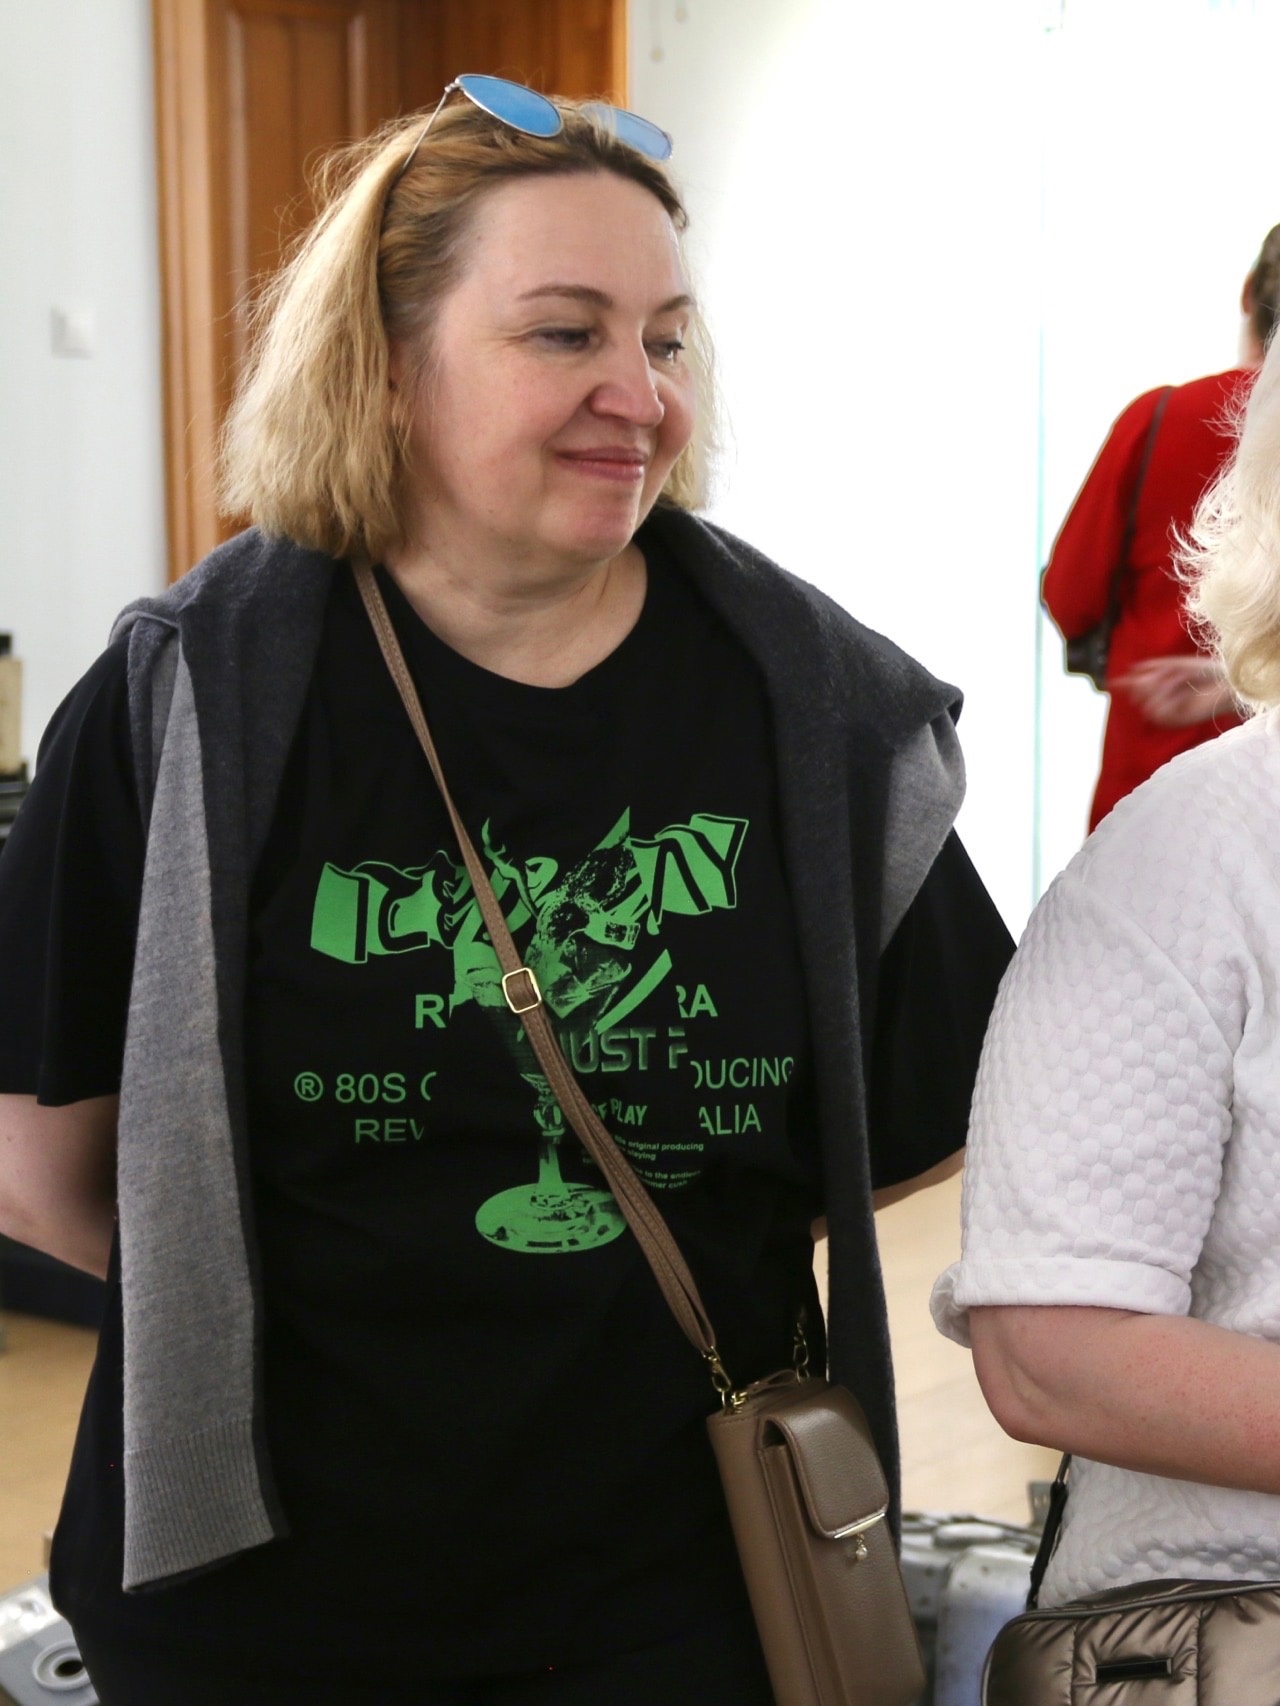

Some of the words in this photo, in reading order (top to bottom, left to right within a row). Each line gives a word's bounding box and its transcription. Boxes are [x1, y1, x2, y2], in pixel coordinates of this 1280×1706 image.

[335, 1072, 407, 1104] 80S
[609, 1098, 648, 1127] PLAY
[699, 1103, 762, 1136] ALIA
[627, 1141, 659, 1151] original
[661, 1143, 704, 1152] producing
